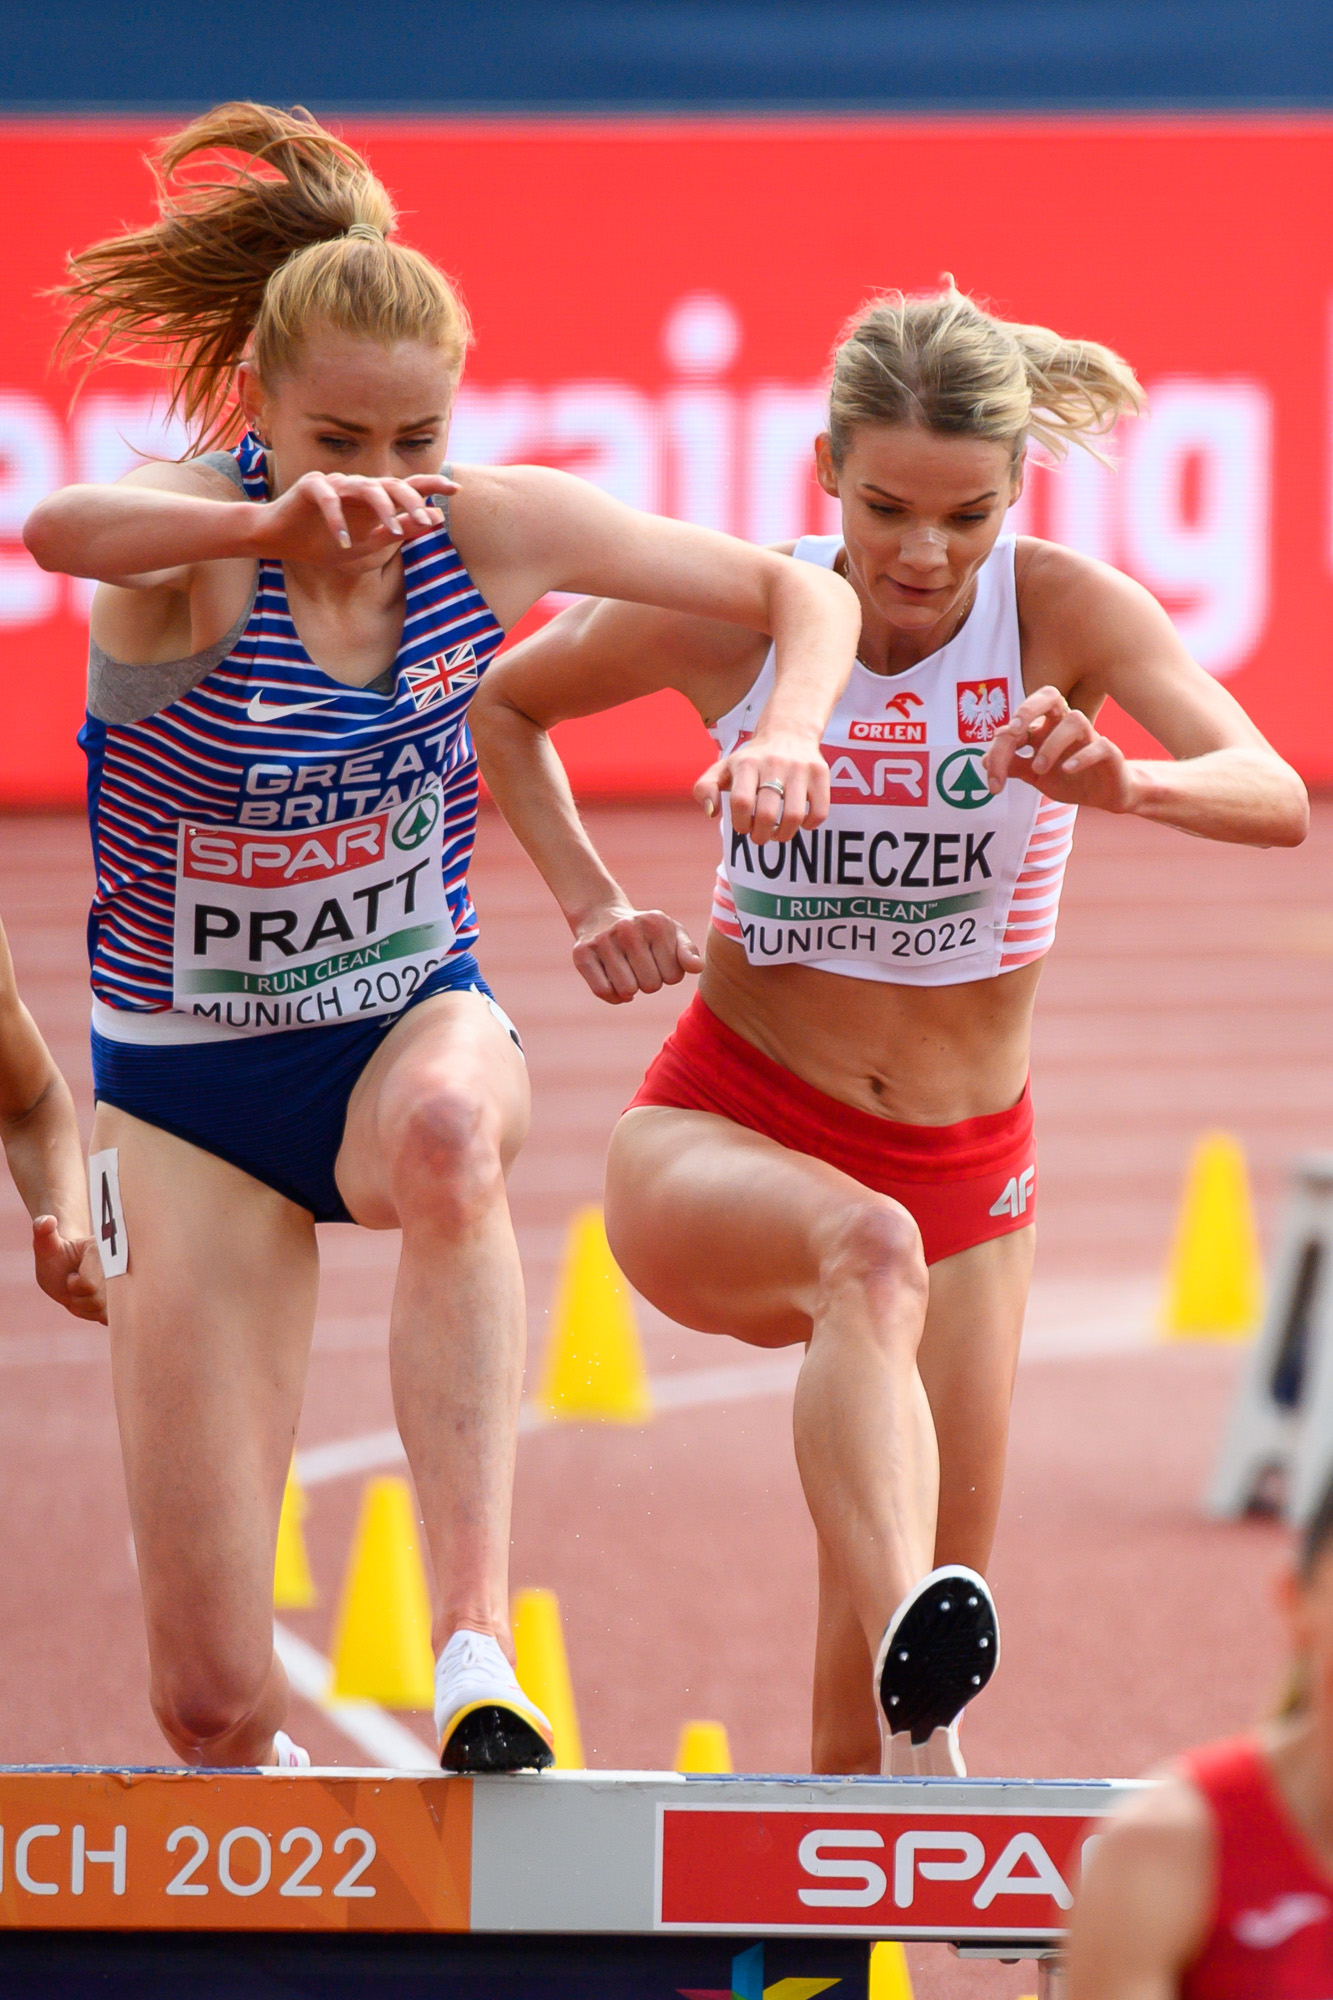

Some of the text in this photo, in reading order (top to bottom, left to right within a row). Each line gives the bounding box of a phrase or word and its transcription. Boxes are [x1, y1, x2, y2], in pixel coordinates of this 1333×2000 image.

[245, 724, 457, 796] GREAT
[853, 723, 923, 741] ORLEN
[830, 755, 924, 798] AR
[190, 821, 380, 880] SPAR
[193, 857, 431, 963] PRATT
[775, 898, 782, 916] I
[789, 898, 842, 919] RUN
[892, 917, 977, 957] 2022
[243, 975, 249, 991] I
[258, 970, 308, 993] RUN
[101, 1170, 118, 1257] 4
[988, 1163, 1035, 1219] 4F
[166, 1825, 377, 1898] 2022
[798, 1829, 1100, 1911] SPA
